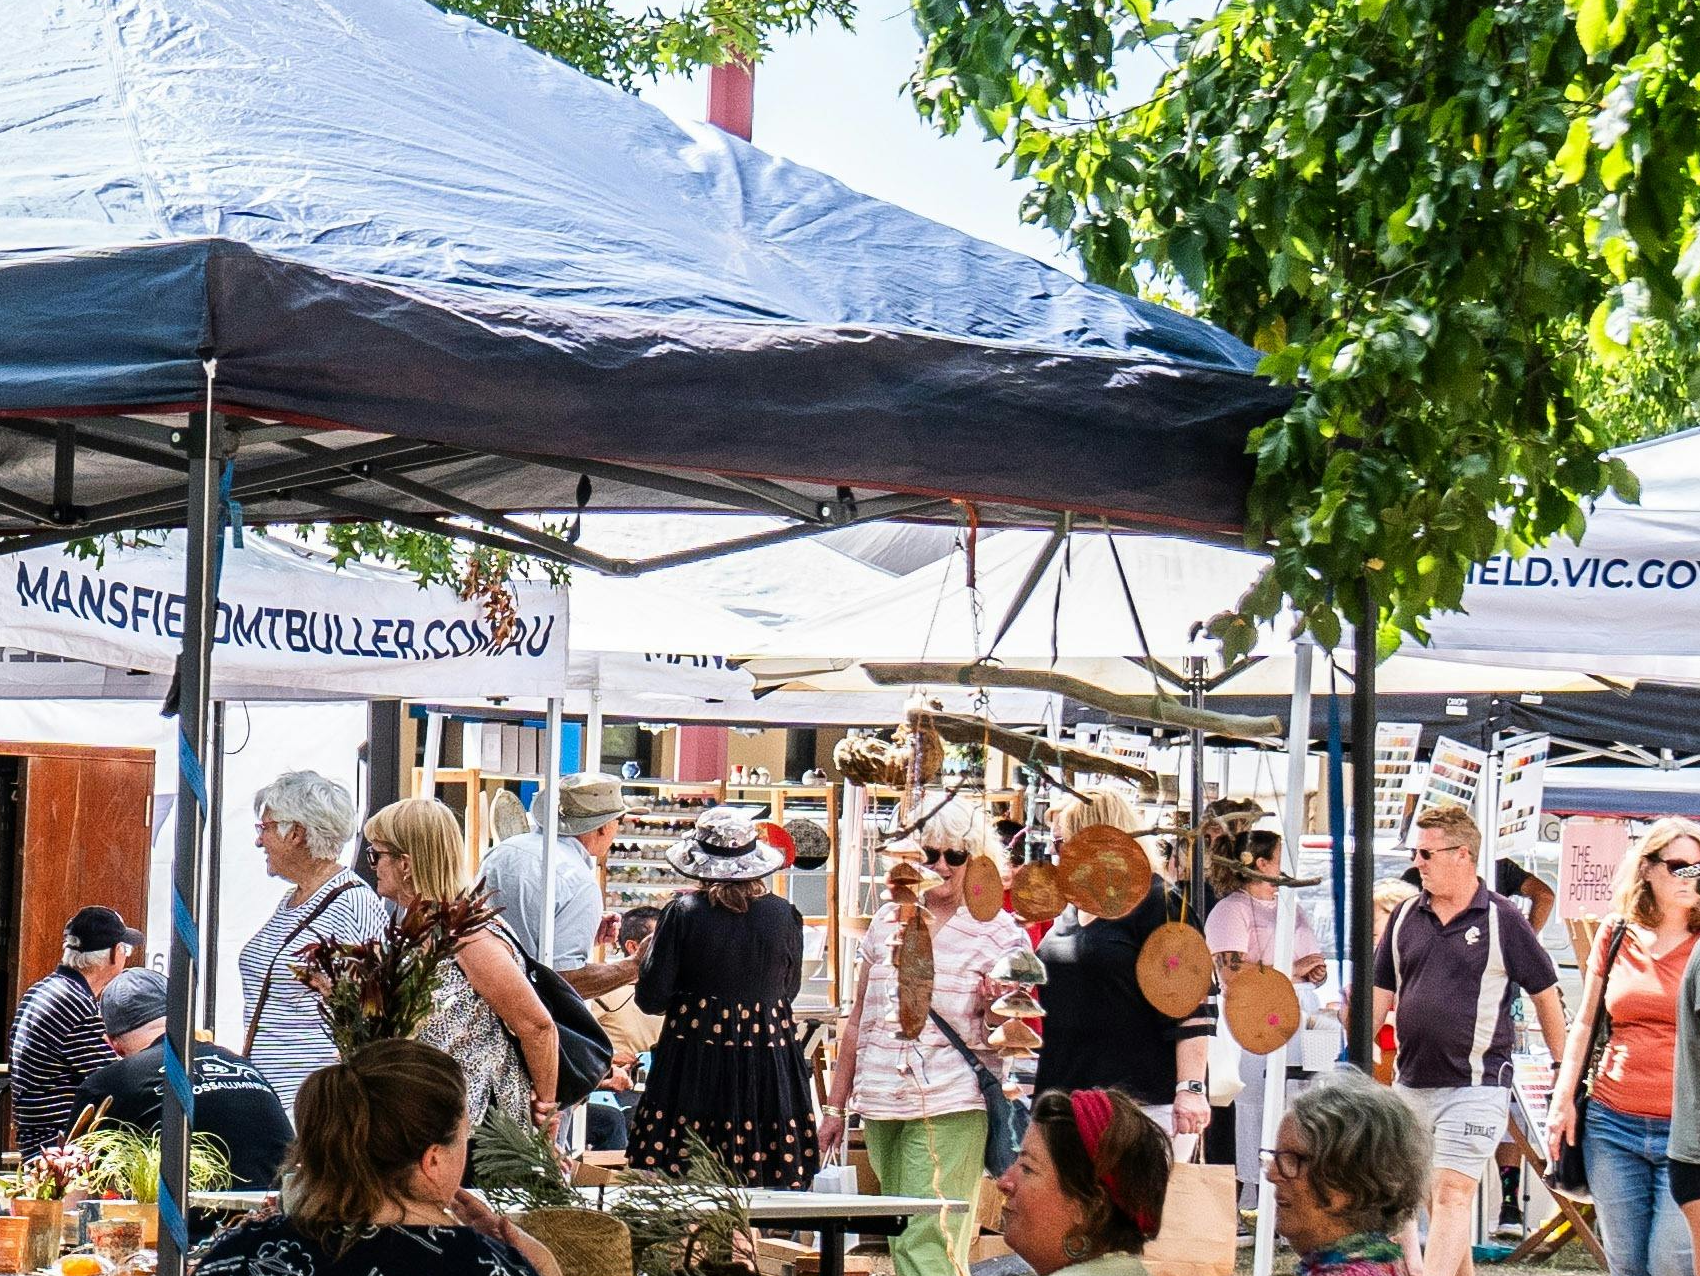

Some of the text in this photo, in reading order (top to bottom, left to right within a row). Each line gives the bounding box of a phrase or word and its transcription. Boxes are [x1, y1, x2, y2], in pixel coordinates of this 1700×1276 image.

[1572, 845, 1591, 863] THE
[1571, 864, 1616, 882] TUESDAY
[1569, 883, 1613, 901] POTTERS
